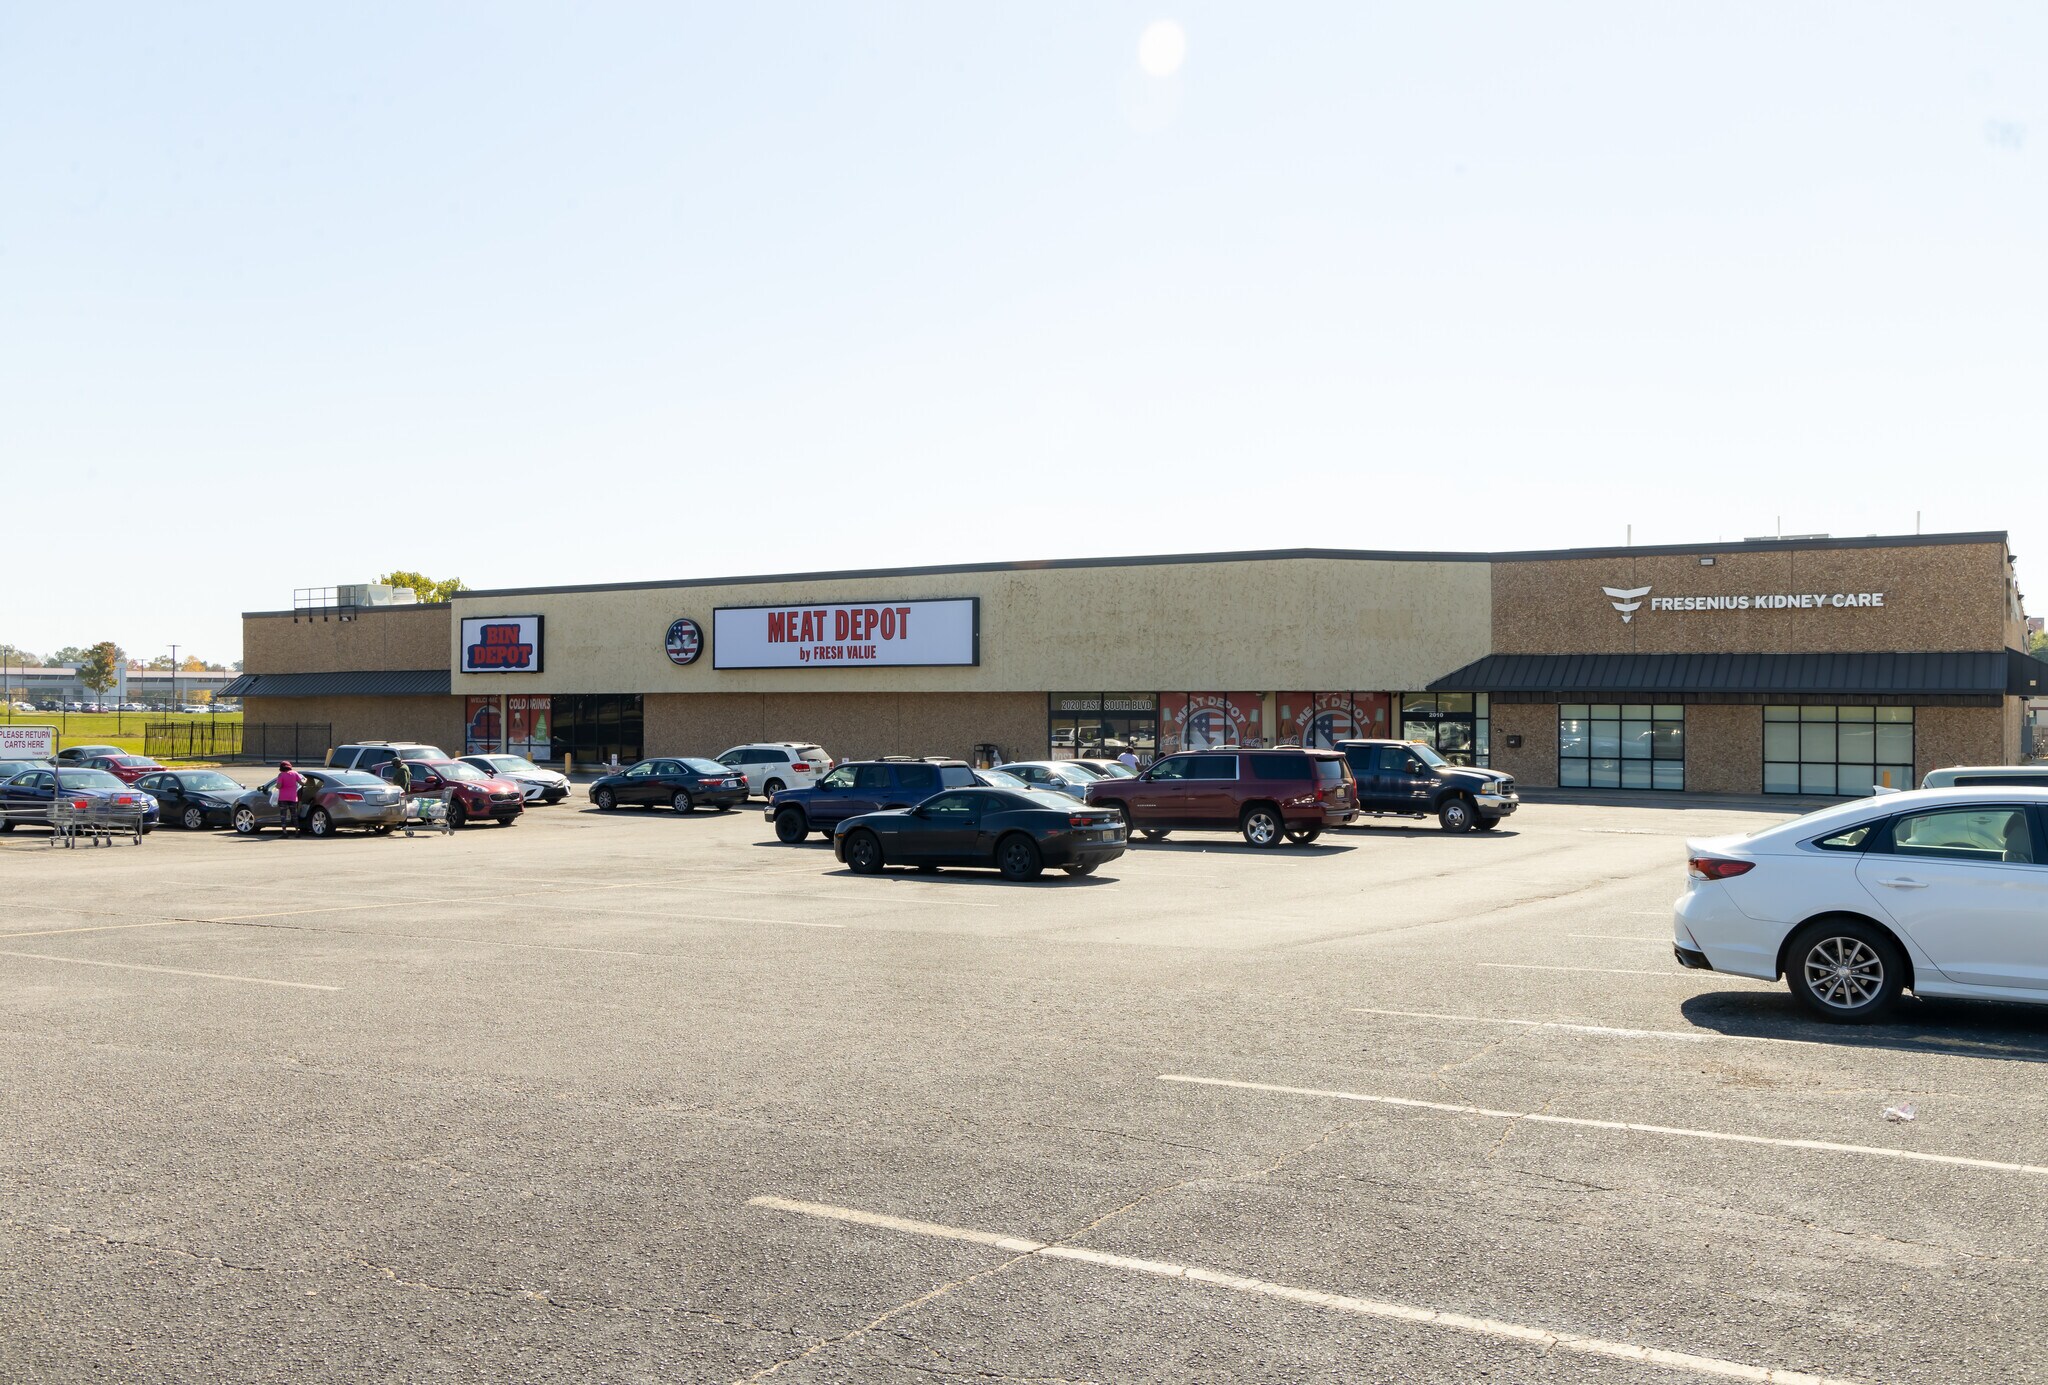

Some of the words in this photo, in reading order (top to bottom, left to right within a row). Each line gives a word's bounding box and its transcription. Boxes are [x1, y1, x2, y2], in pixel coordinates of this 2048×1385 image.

[1651, 595, 1749, 611] FRESENIUS
[1755, 594, 1827, 609] KIDNEY
[1831, 593, 1884, 608] CARE
[767, 610, 828, 643] MEAT
[835, 607, 911, 641] DEPOT
[484, 625, 519, 645] BIN
[471, 644, 533, 665] DEPOT
[799, 646, 811, 662] by
[813, 645, 844, 660] FRESH
[847, 644, 877, 659] VALUE
[509, 698, 526, 710] COLD
[527, 698, 551, 710] DRINKS
[1061, 700, 1080, 710] 2020
[1080, 700, 1100, 710] EAST
[1104, 700, 1130, 710] SOUTH
[1175, 697, 1204, 725] MEAT
[1208, 696, 1246, 724] DEPOT
[1296, 698, 1328, 727] MEAT
[1331, 698, 1371, 726] DEPOT
[25, 731, 51, 739] RETURN
[4, 741, 26, 749] CARTS
[27, 741, 45, 749] HERE
